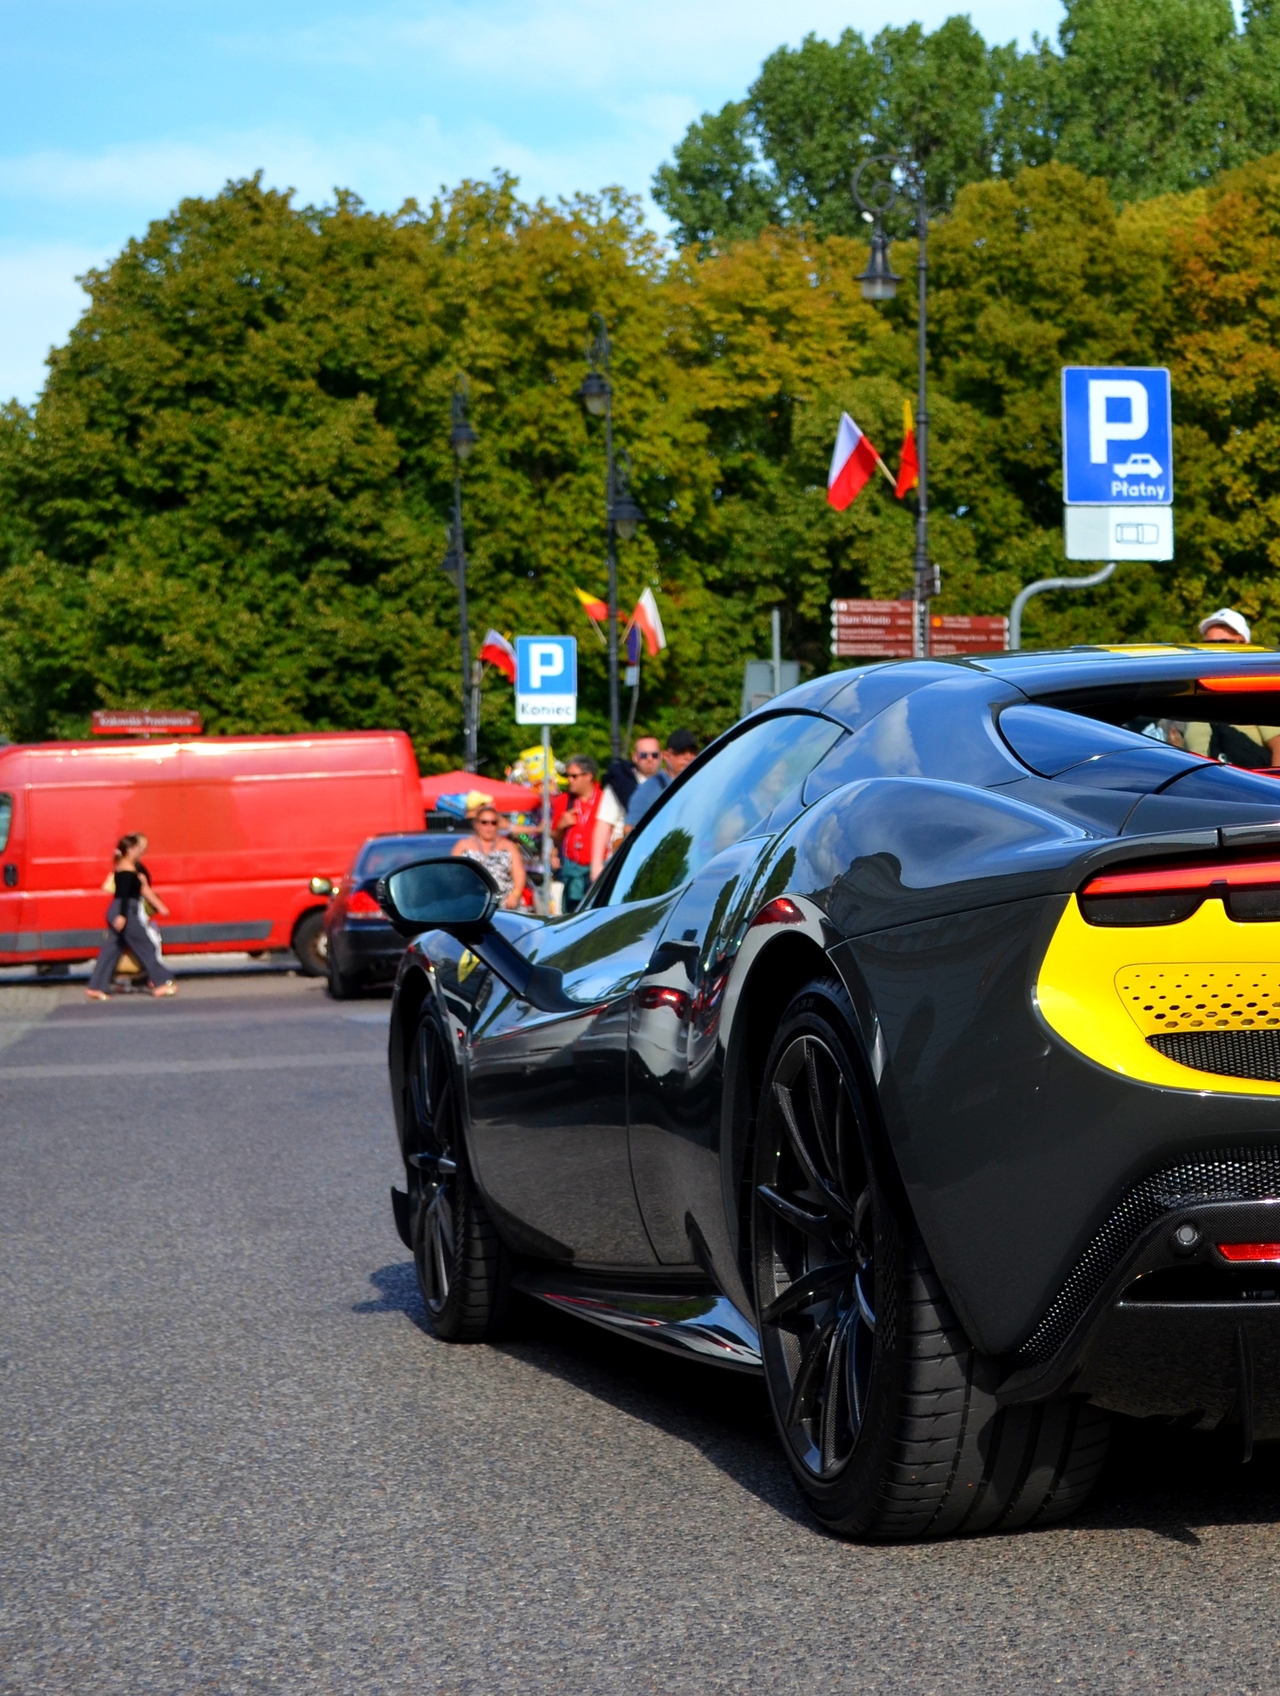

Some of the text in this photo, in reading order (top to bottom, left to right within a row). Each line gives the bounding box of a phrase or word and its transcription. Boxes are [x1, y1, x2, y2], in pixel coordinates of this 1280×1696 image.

[1088, 379, 1149, 464] P
[1111, 480, 1166, 500] Płatny
[528, 642, 565, 689] P
[521, 703, 572, 716] Koniec
